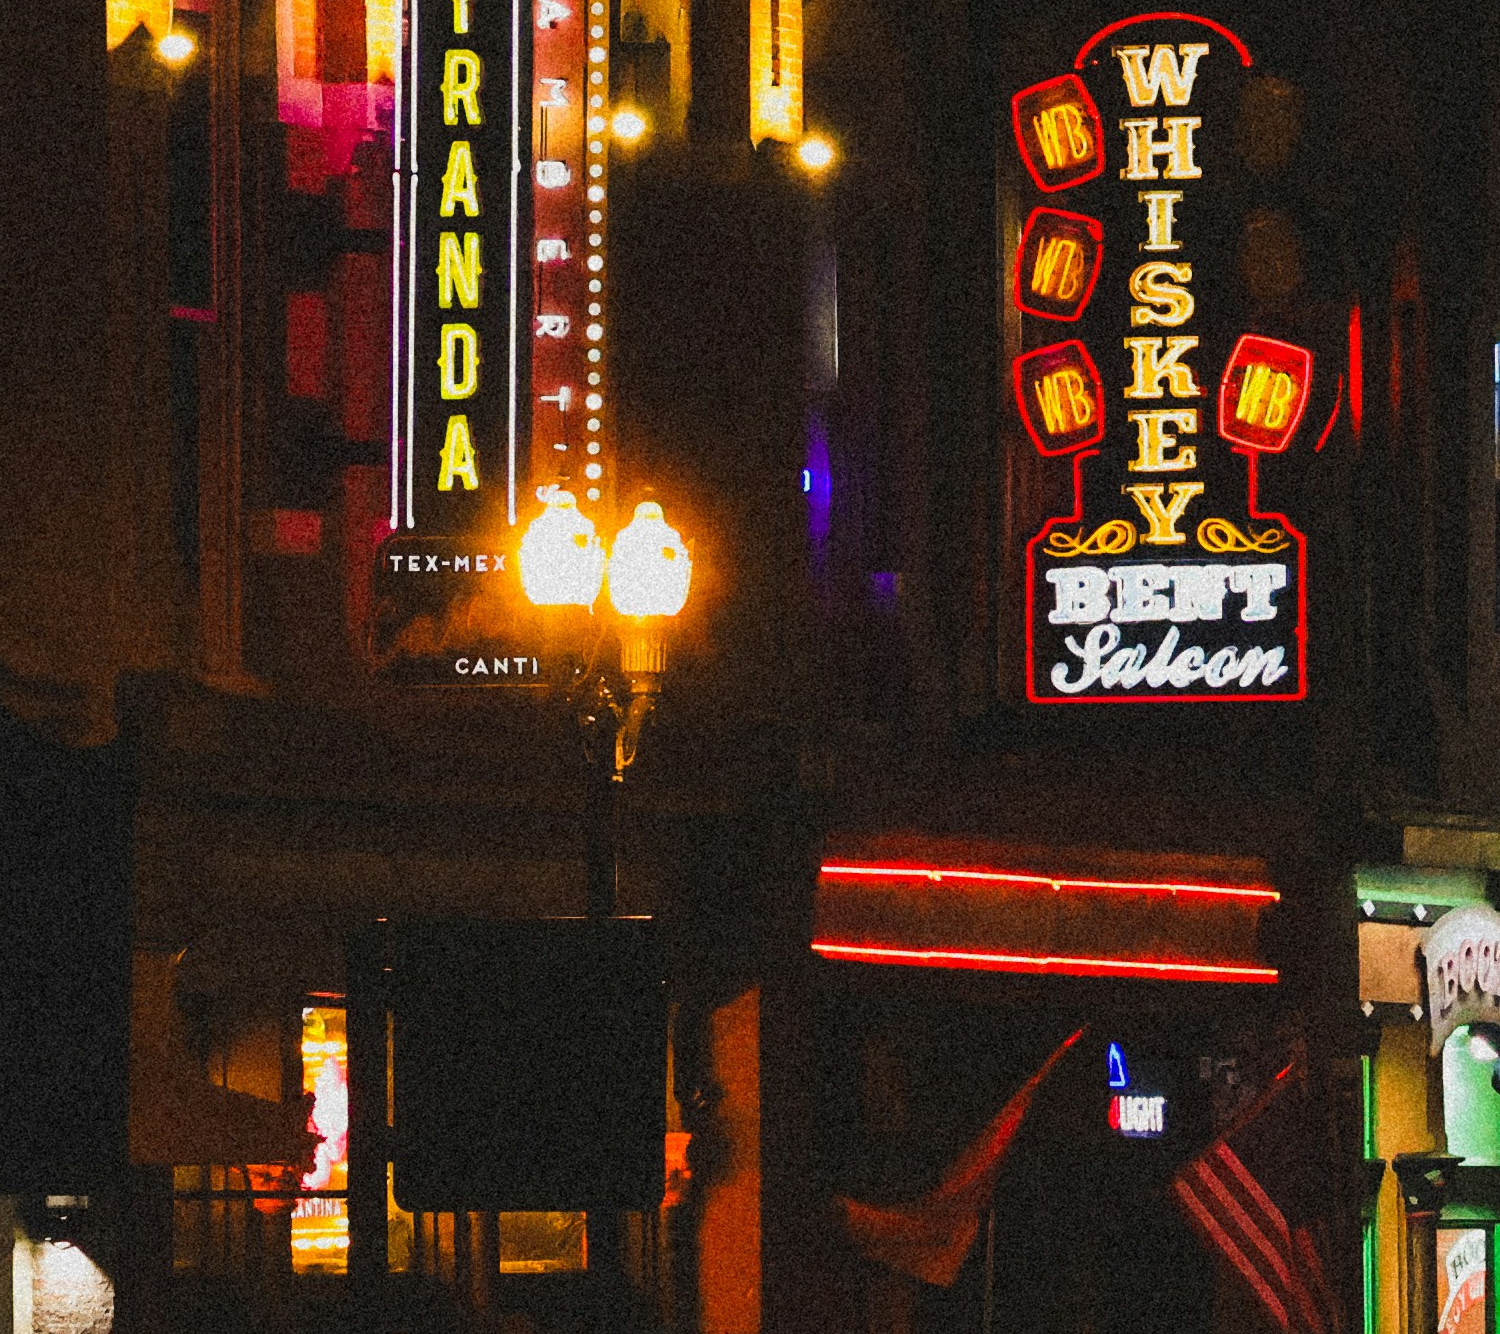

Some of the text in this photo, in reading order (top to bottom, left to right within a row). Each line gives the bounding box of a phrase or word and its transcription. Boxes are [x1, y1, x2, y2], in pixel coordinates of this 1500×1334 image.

[1112, 43, 1209, 545] WHISKEY
[389, 554, 507, 572] TEX-MEX
[1045, 563, 1288, 624] BENT
[454, 658, 539, 675] CANTI
[1051, 623, 1289, 694] Saloon
[1120, 1095, 1167, 1133] LIGHT
